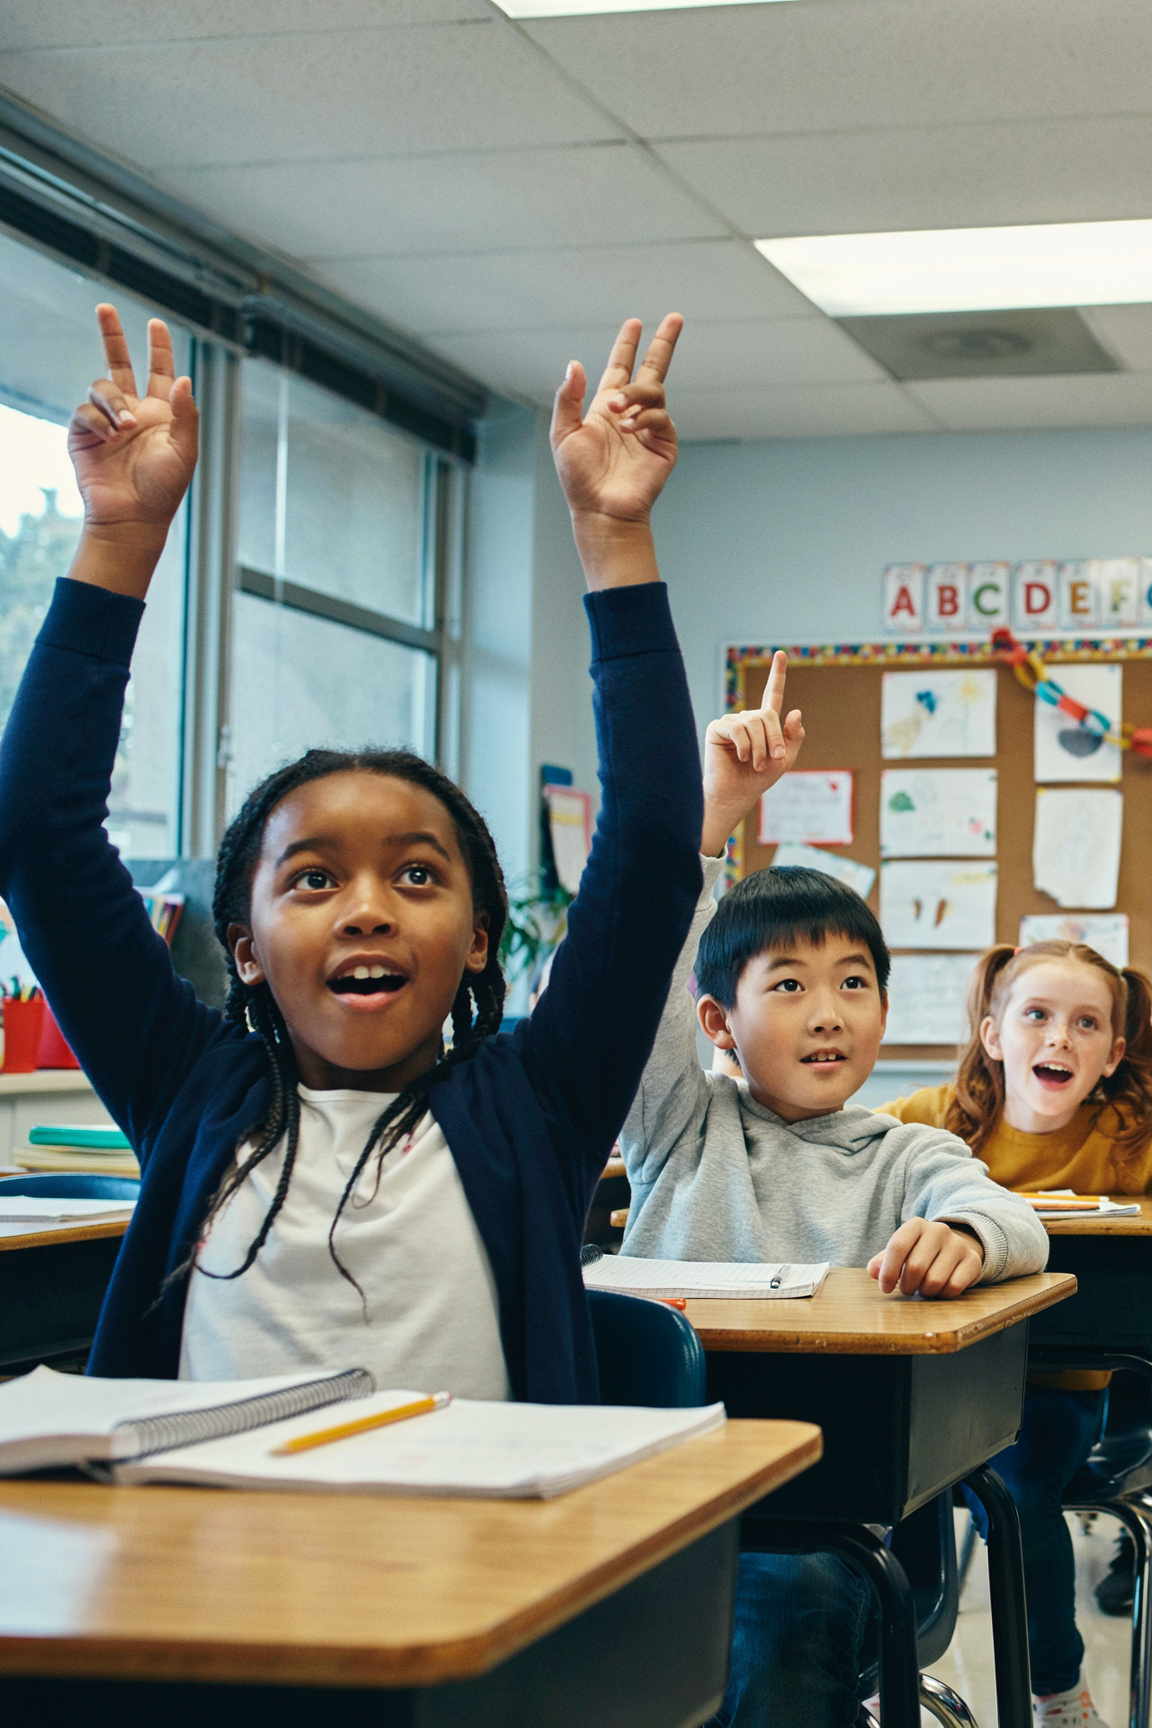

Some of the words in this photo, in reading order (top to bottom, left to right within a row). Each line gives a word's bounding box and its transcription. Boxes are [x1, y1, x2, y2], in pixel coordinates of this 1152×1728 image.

[891, 586, 915, 616] A
[938, 585, 959, 616] B
[972, 583, 1000, 617] C
[1025, 582, 1051, 614] D
[1070, 582, 1089, 614] E
[1110, 580, 1128, 612] F
